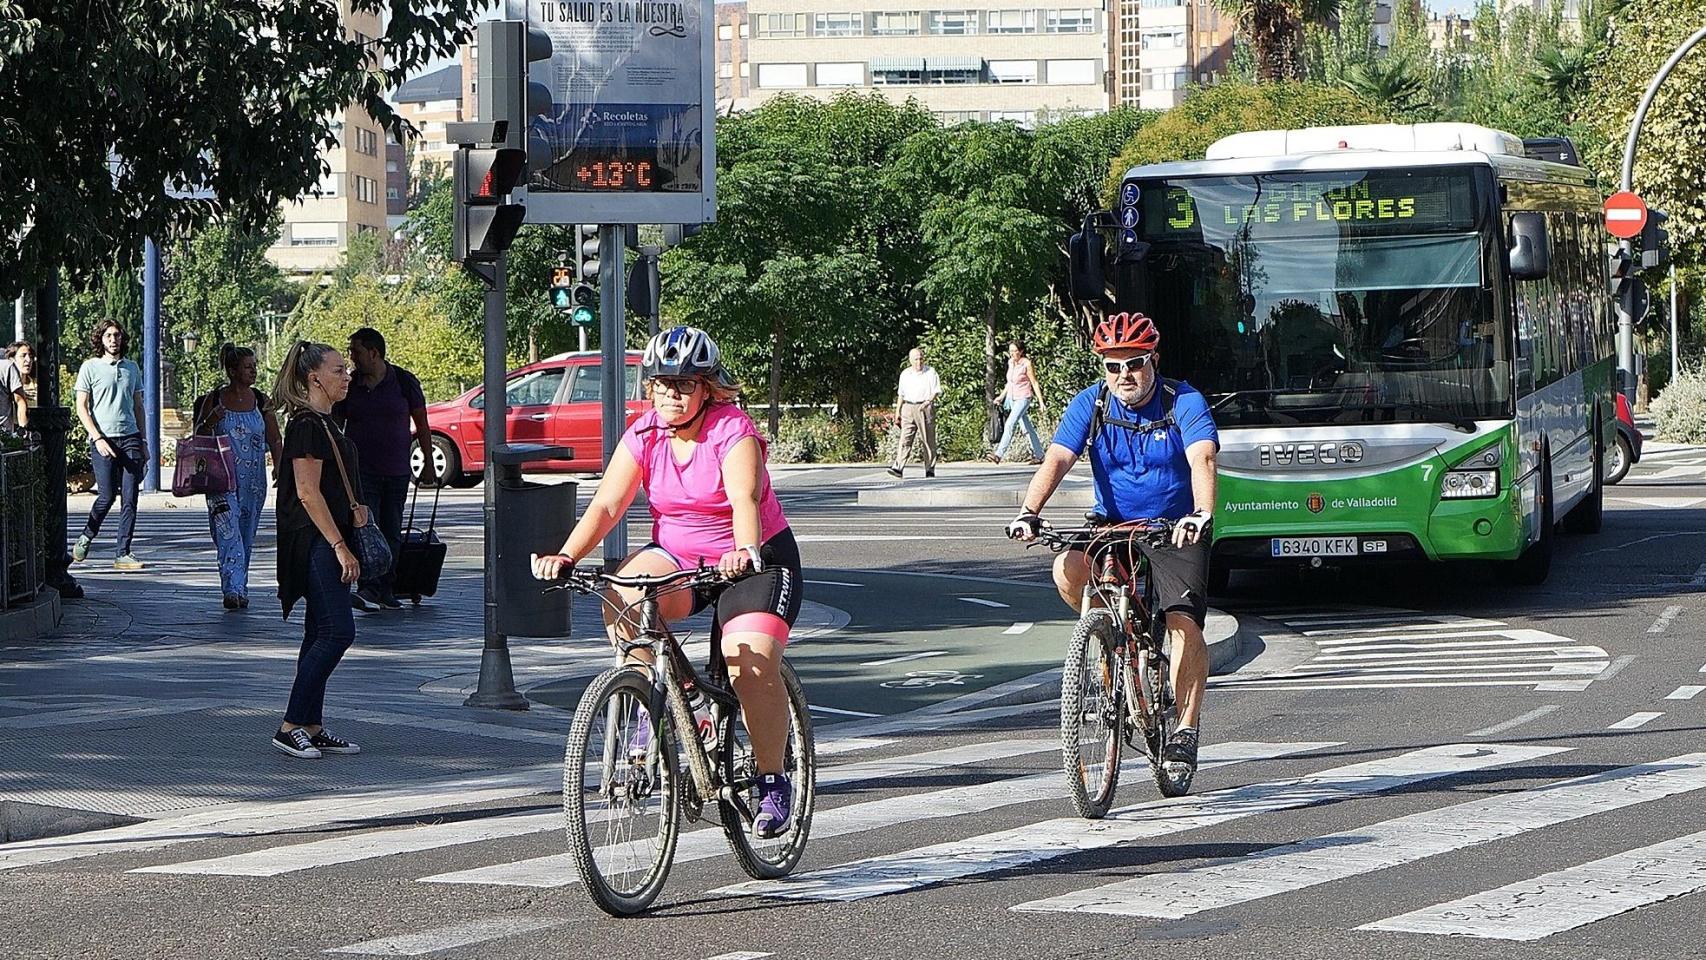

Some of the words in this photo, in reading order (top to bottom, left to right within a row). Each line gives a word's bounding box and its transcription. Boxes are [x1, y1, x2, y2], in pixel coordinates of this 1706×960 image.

[541, 2, 554, 23] TU
[559, 2, 595, 23] SALUD
[600, 2, 613, 23] ES
[618, 2, 631, 23] LA
[635, 0, 687, 38] NUESTRA
[603, 111, 648, 121] Recoletas
[1168, 189, 1195, 229] 3
[1223, 203, 1281, 225] LAS
[1291, 198, 1415, 222] FLORES
[1260, 443, 1364, 466] IVECO
[1421, 465, 1434, 481] 7
[1225, 499, 1299, 511] Ayuntamiento
[1331, 499, 1345, 509] de
[1347, 497, 1397, 508] Valladolid
[1282, 540, 1320, 554] 6340
[1325, 539, 1354, 553] KFK
[1365, 541, 1385, 551] SP
